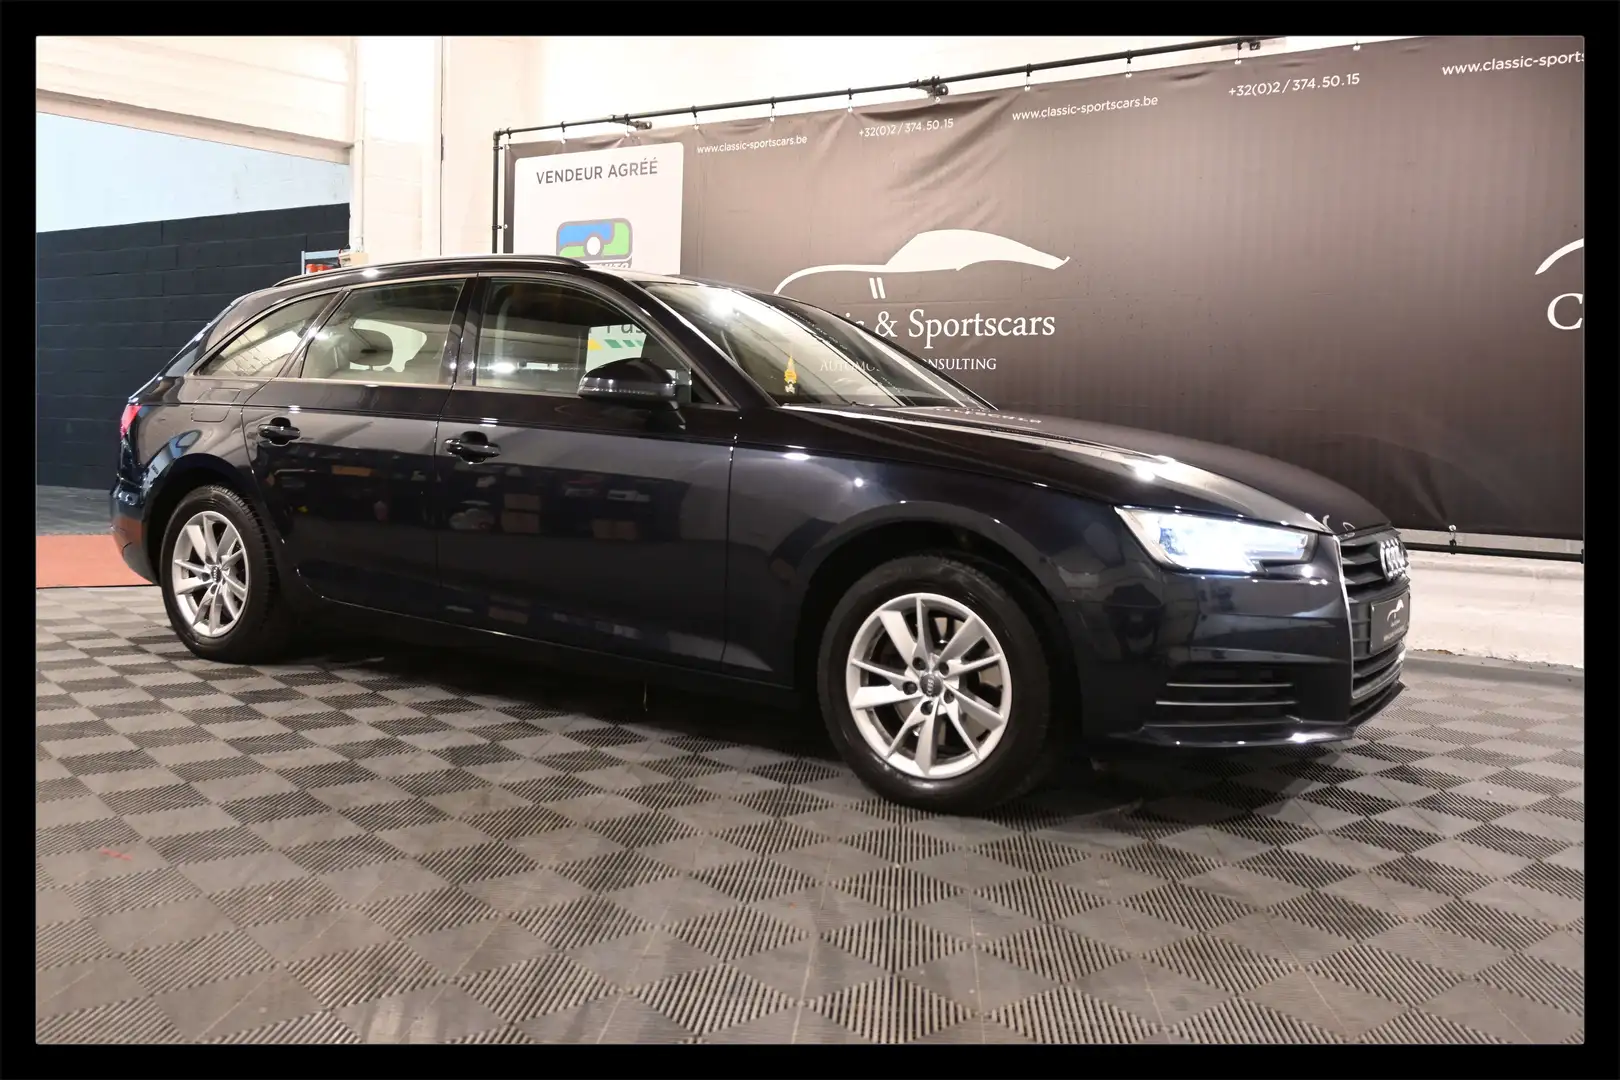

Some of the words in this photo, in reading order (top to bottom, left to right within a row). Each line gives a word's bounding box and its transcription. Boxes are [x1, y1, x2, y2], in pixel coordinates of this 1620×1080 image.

[1012, 95, 1159, 121] www.classic-sportscars.be
[696, 135, 808, 154] www.classic-sportscars.be
[536, 166, 603, 185] VENDEUR
[607, 157, 658, 178] AGRÉÉ
[875, 311, 898, 338] &
[908, 308, 1056, 349] Sportscars
